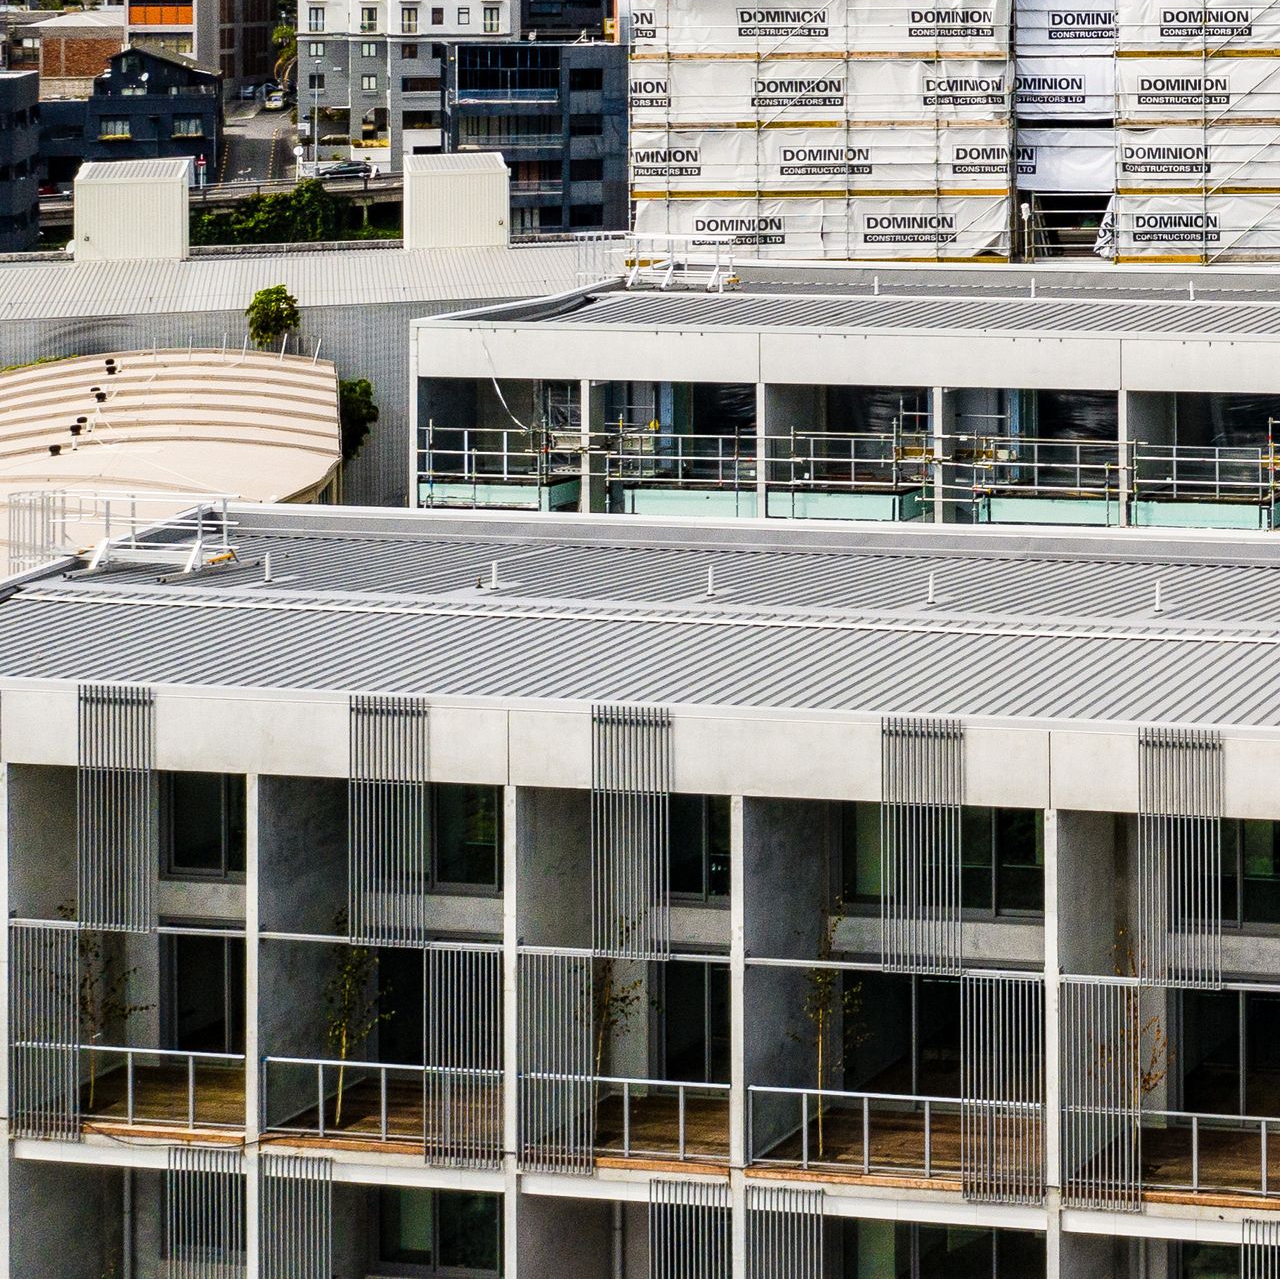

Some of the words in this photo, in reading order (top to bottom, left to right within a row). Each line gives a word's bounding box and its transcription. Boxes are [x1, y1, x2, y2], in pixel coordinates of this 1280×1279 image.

[1141, 79, 1227, 91] DOMINION
[783, 148, 869, 161] DOMINION
[867, 216, 953, 229] DOMINION
[1135, 216, 1217, 228] DOMINION
